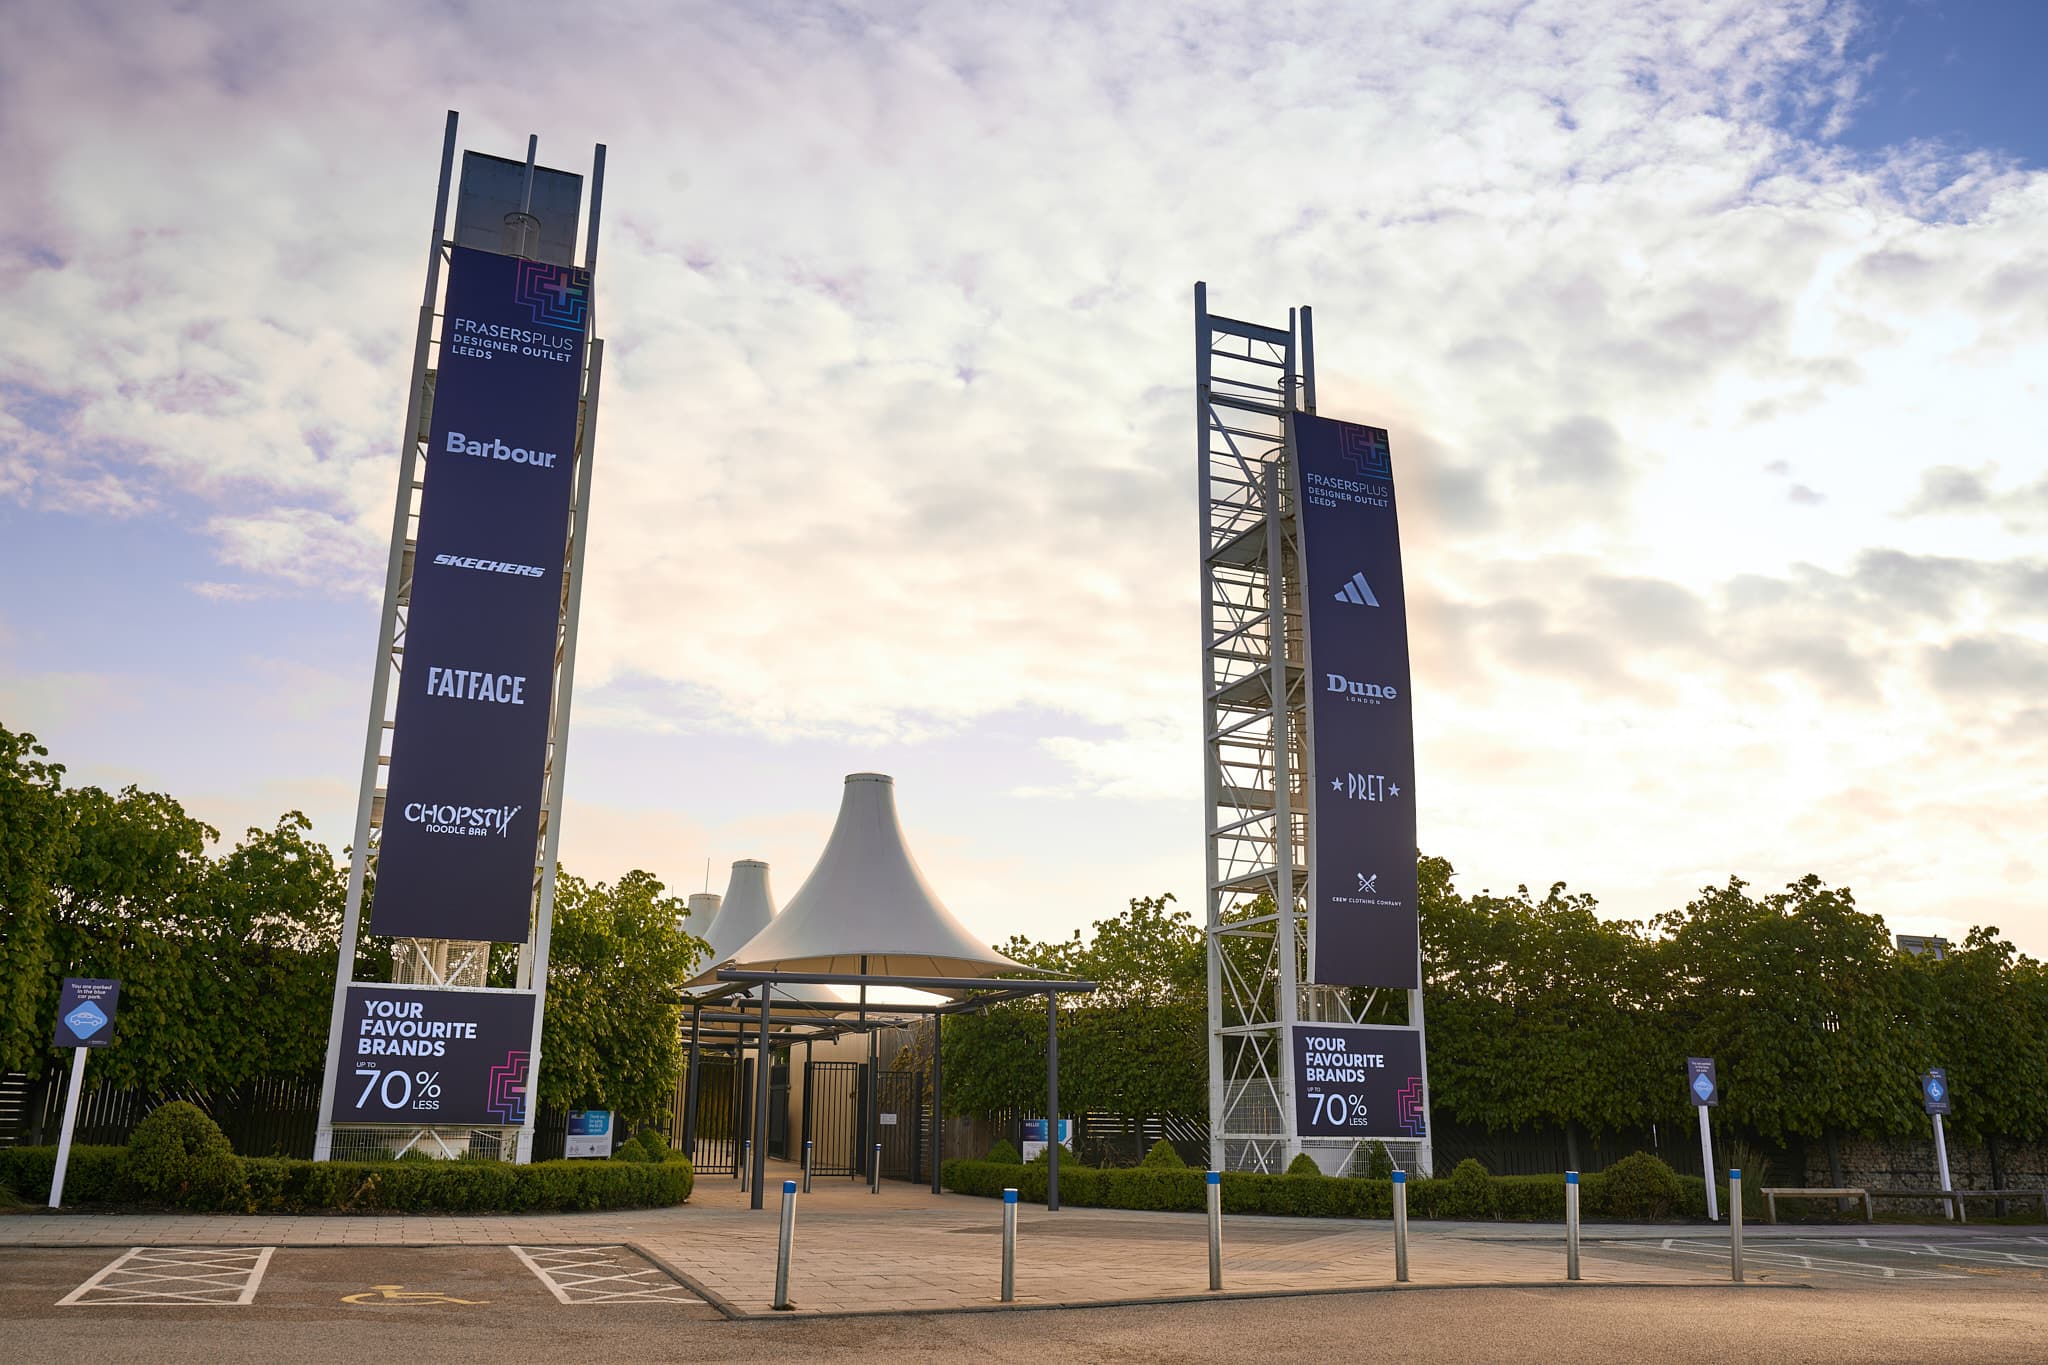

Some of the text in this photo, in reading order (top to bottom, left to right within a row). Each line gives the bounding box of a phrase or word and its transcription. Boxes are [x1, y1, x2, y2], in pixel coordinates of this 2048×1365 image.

[452, 344, 493, 361] LEEDS
[453, 333, 572, 363] DESIGNER OUTLET
[1308, 486, 1389, 508] DESIGNER OUTLET
[1309, 495, 1337, 508] LEEDS
[433, 553, 546, 578] SKECHERS
[426, 666, 526, 705] FATFACE
[1326, 673, 1398, 700] Dune
[1346, 696, 1381, 705] LONDON
[1348, 772, 1385, 802] PRET
[426, 824, 488, 837] NOODLE BAR
[1348, 897, 1375, 905] CLOTHING
[1376, 899, 1402, 907] COMPANY
[364, 1000, 424, 1019] YOUR
[360, 1019, 478, 1040] FAVOURITE
[358, 1038, 446, 1057] BRANDS
[1305, 1036, 1346, 1052] YOUR
[1305, 1052, 1385, 1068] FAVOURITE
[1306, 1067, 1366, 1083] BRANDS
[412, 1100, 440, 1110] LESS
[1349, 1117, 1368, 1126] LESS
